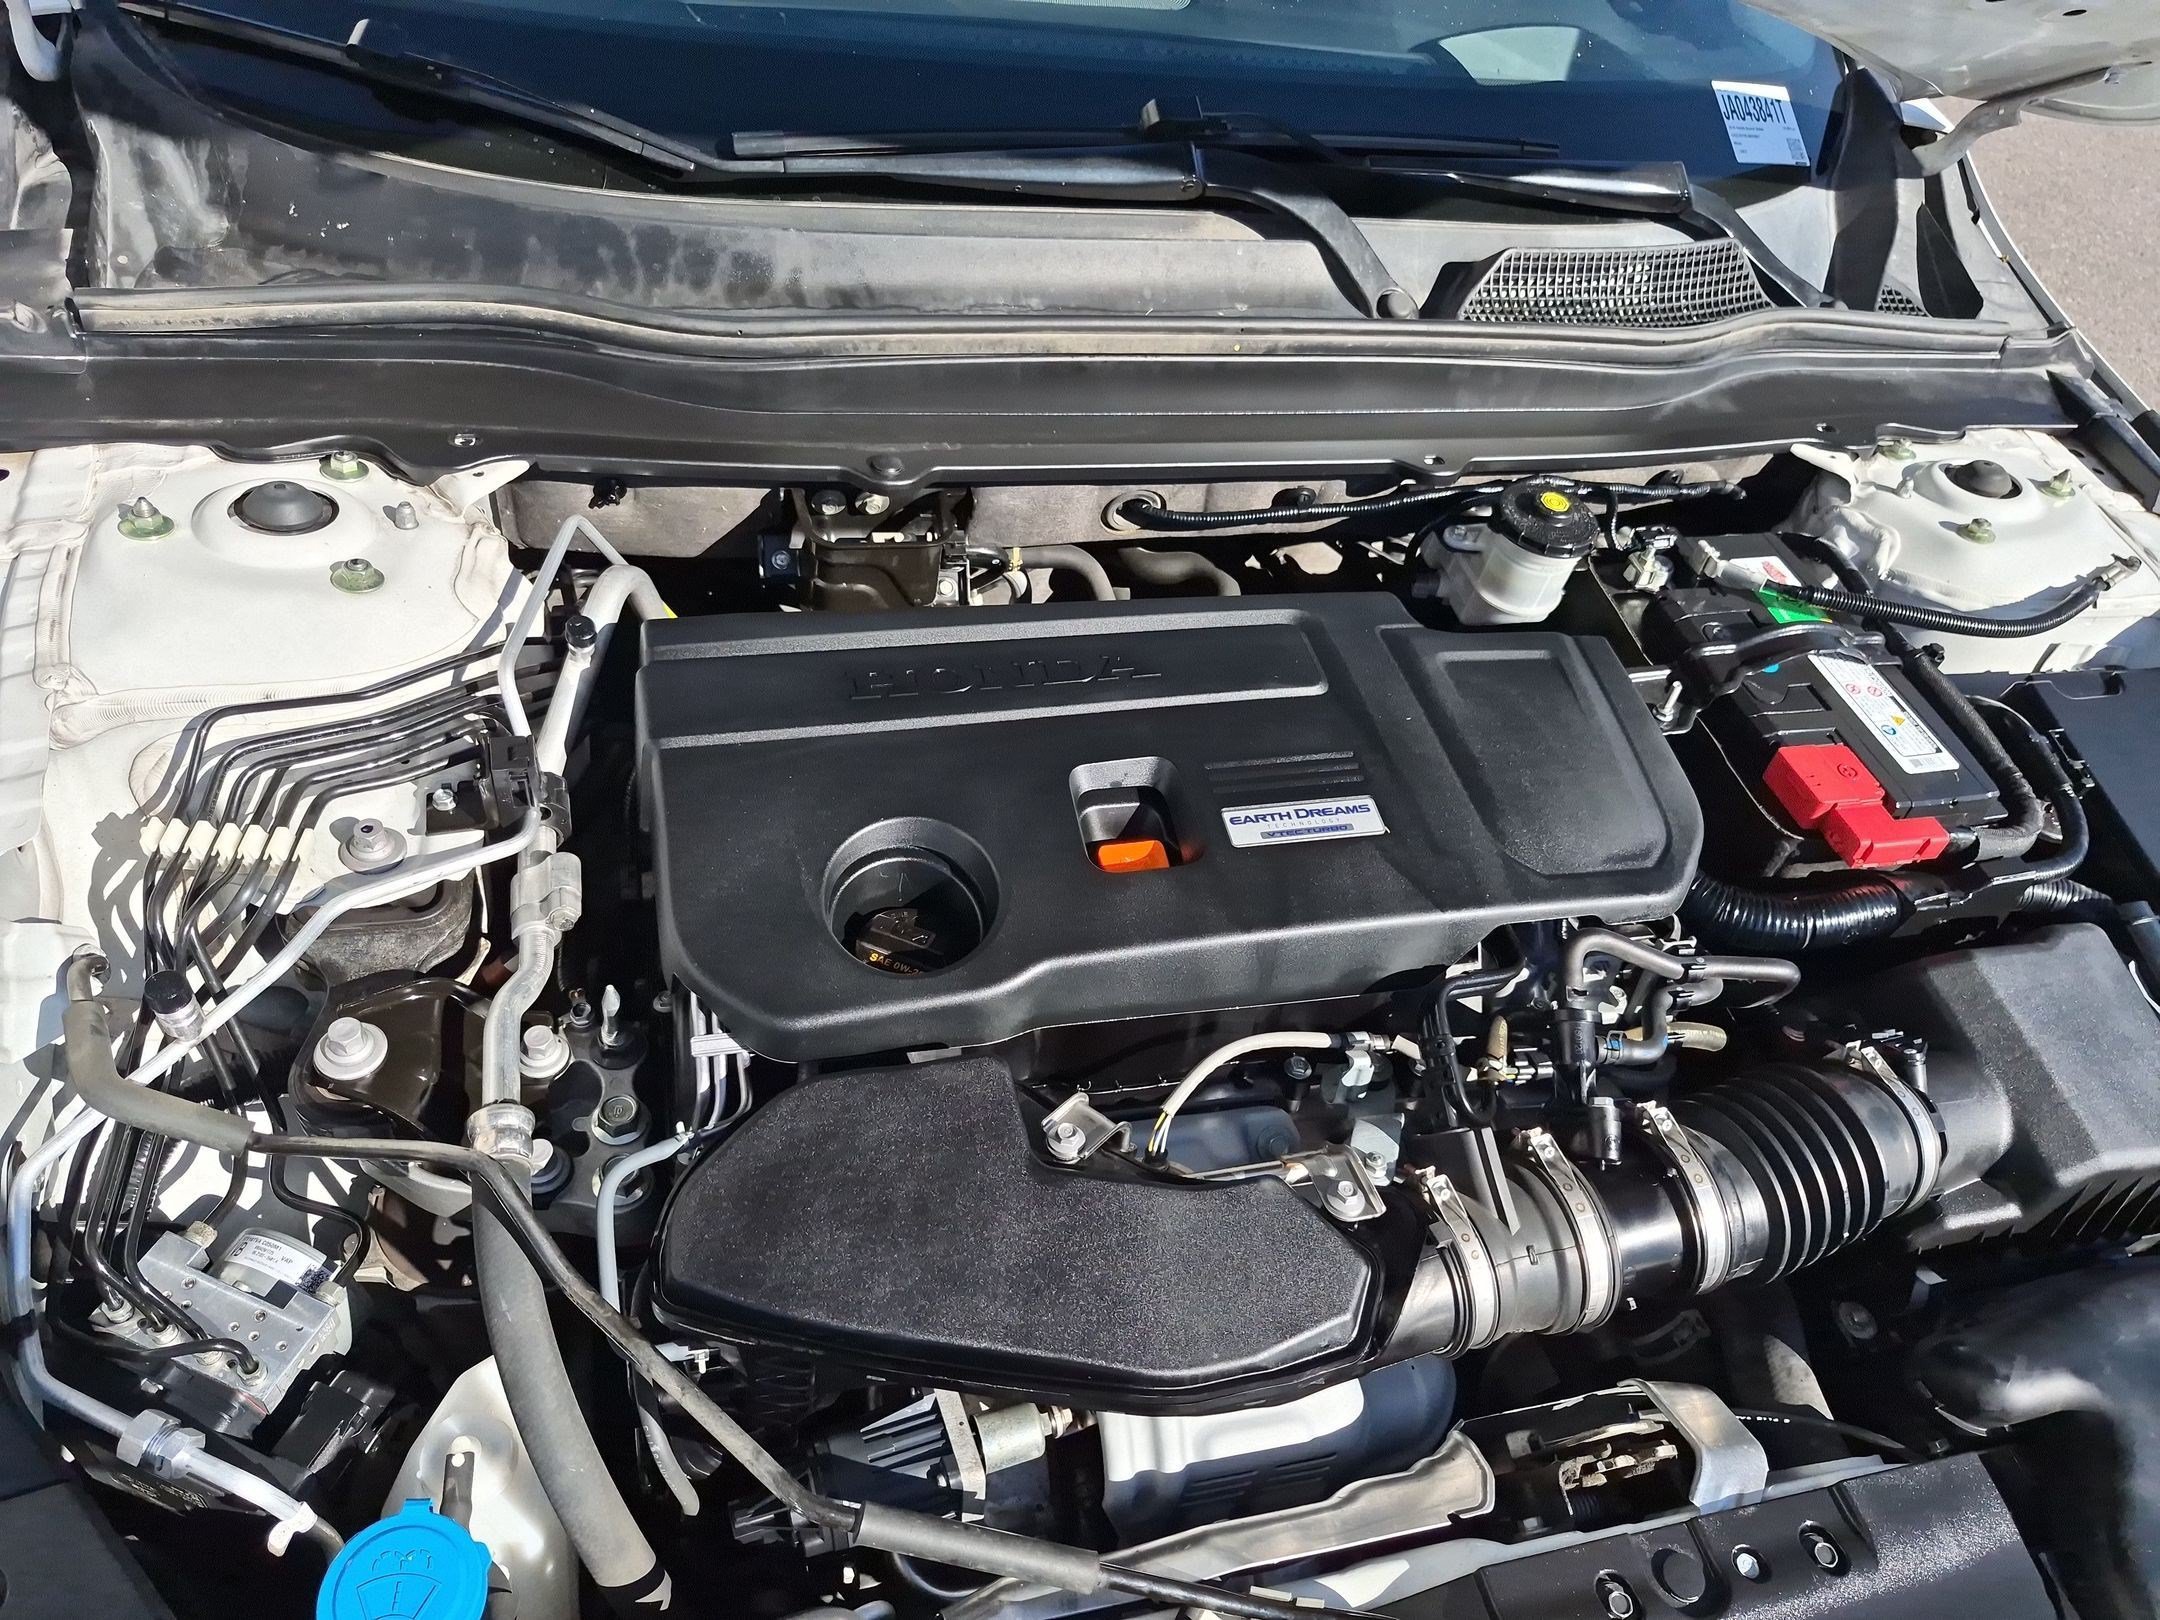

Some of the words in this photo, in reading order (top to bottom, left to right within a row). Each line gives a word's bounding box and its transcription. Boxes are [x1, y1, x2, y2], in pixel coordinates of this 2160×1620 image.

[1721, 94, 1786, 123] JA043841T
[846, 656, 1162, 700] HONDA
[1229, 811, 1292, 825] EARTH
[1295, 804, 1371, 819] DREAMS
[1267, 817, 1341, 829] TECHNOLOGY
[869, 952, 893, 967] SAE
[893, 962, 922, 977] 0W-2
